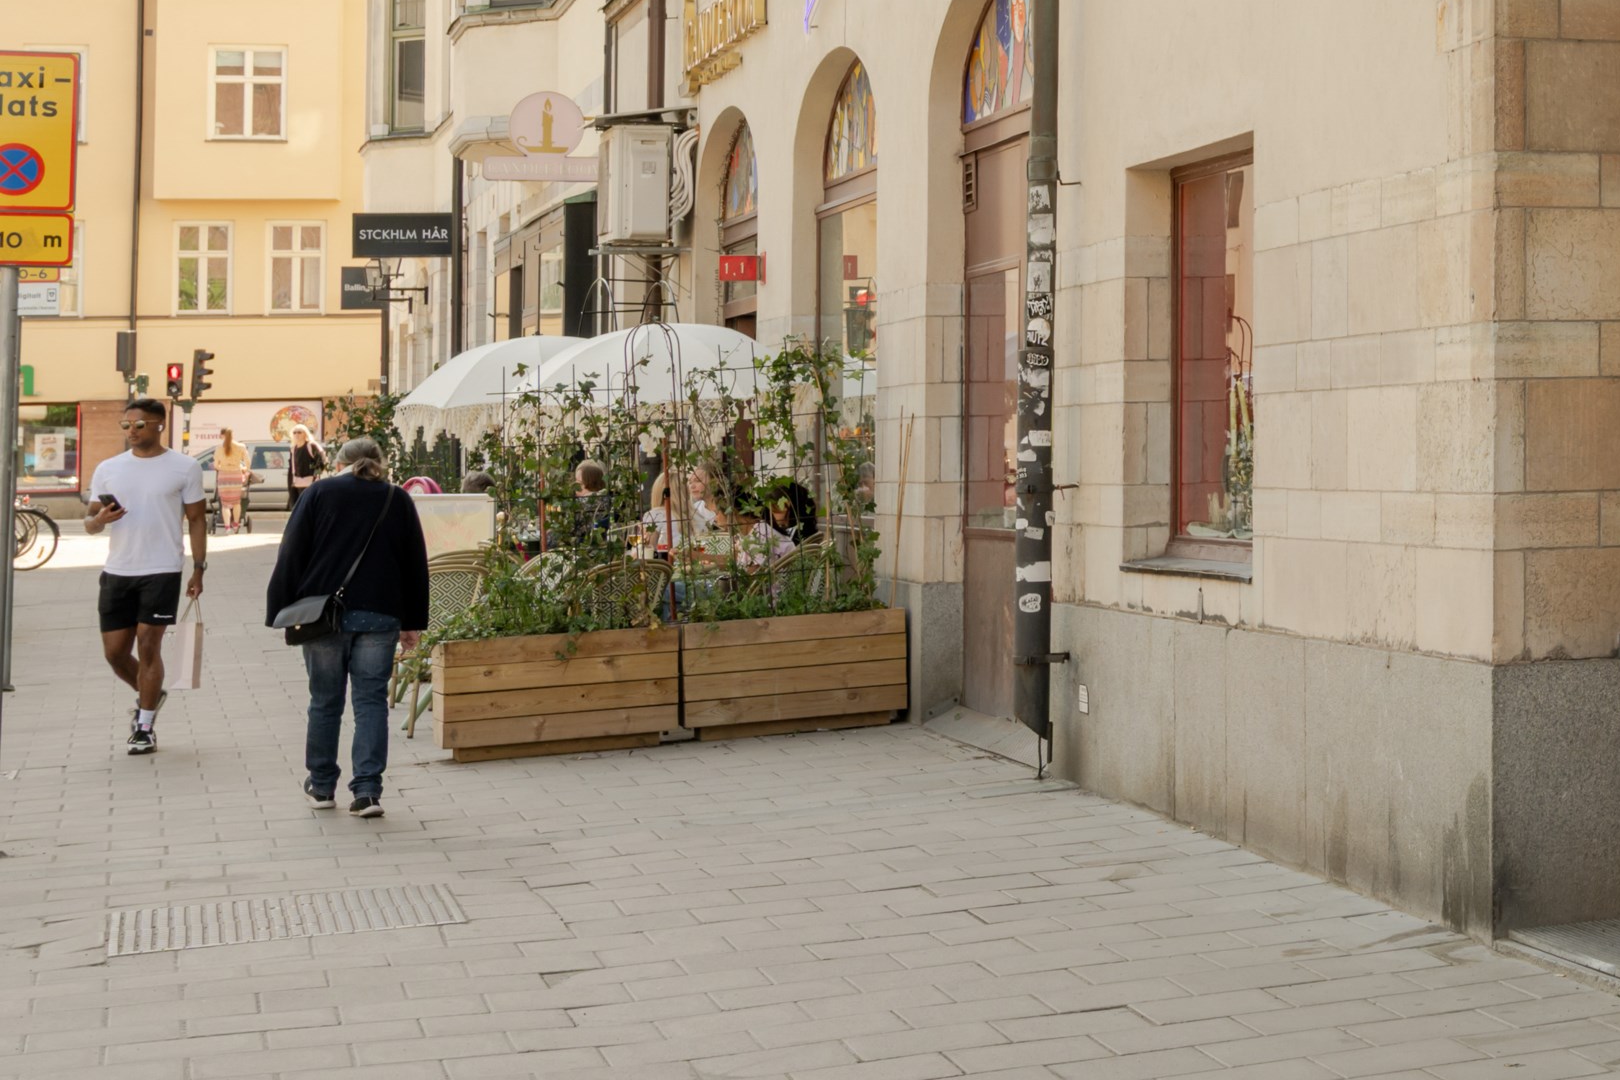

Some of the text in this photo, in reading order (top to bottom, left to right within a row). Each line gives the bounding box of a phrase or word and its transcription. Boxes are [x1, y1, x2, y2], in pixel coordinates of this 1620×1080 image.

[359, 226, 448, 240] STCKHLM HÅR
[43, 235, 62, 248] m
